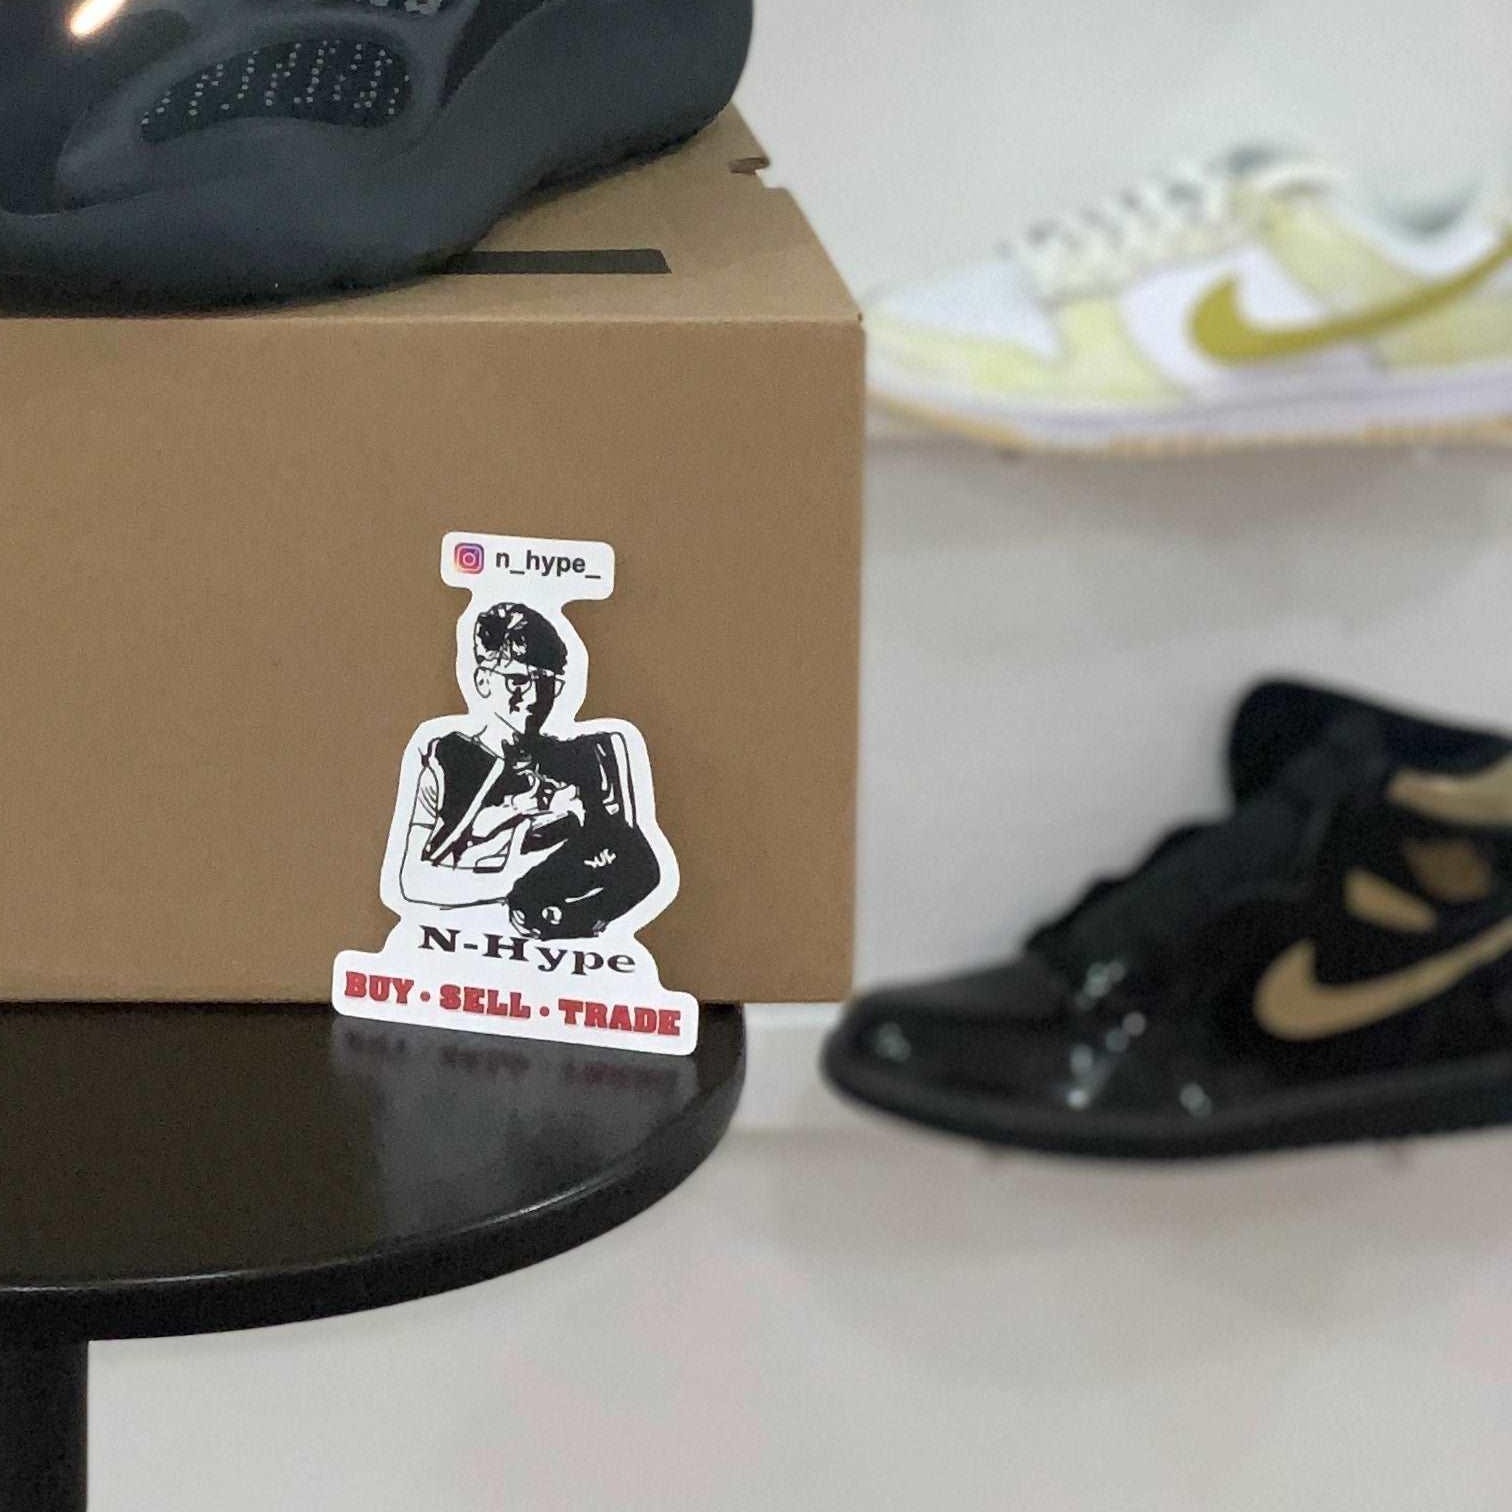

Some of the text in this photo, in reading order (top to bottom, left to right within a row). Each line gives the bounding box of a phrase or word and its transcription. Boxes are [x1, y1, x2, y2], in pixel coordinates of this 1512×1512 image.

[495, 549, 601, 580] n_hype_
[418, 925, 636, 976] N-Hype
[344, 971, 681, 1036] BUY SELL TRADE
